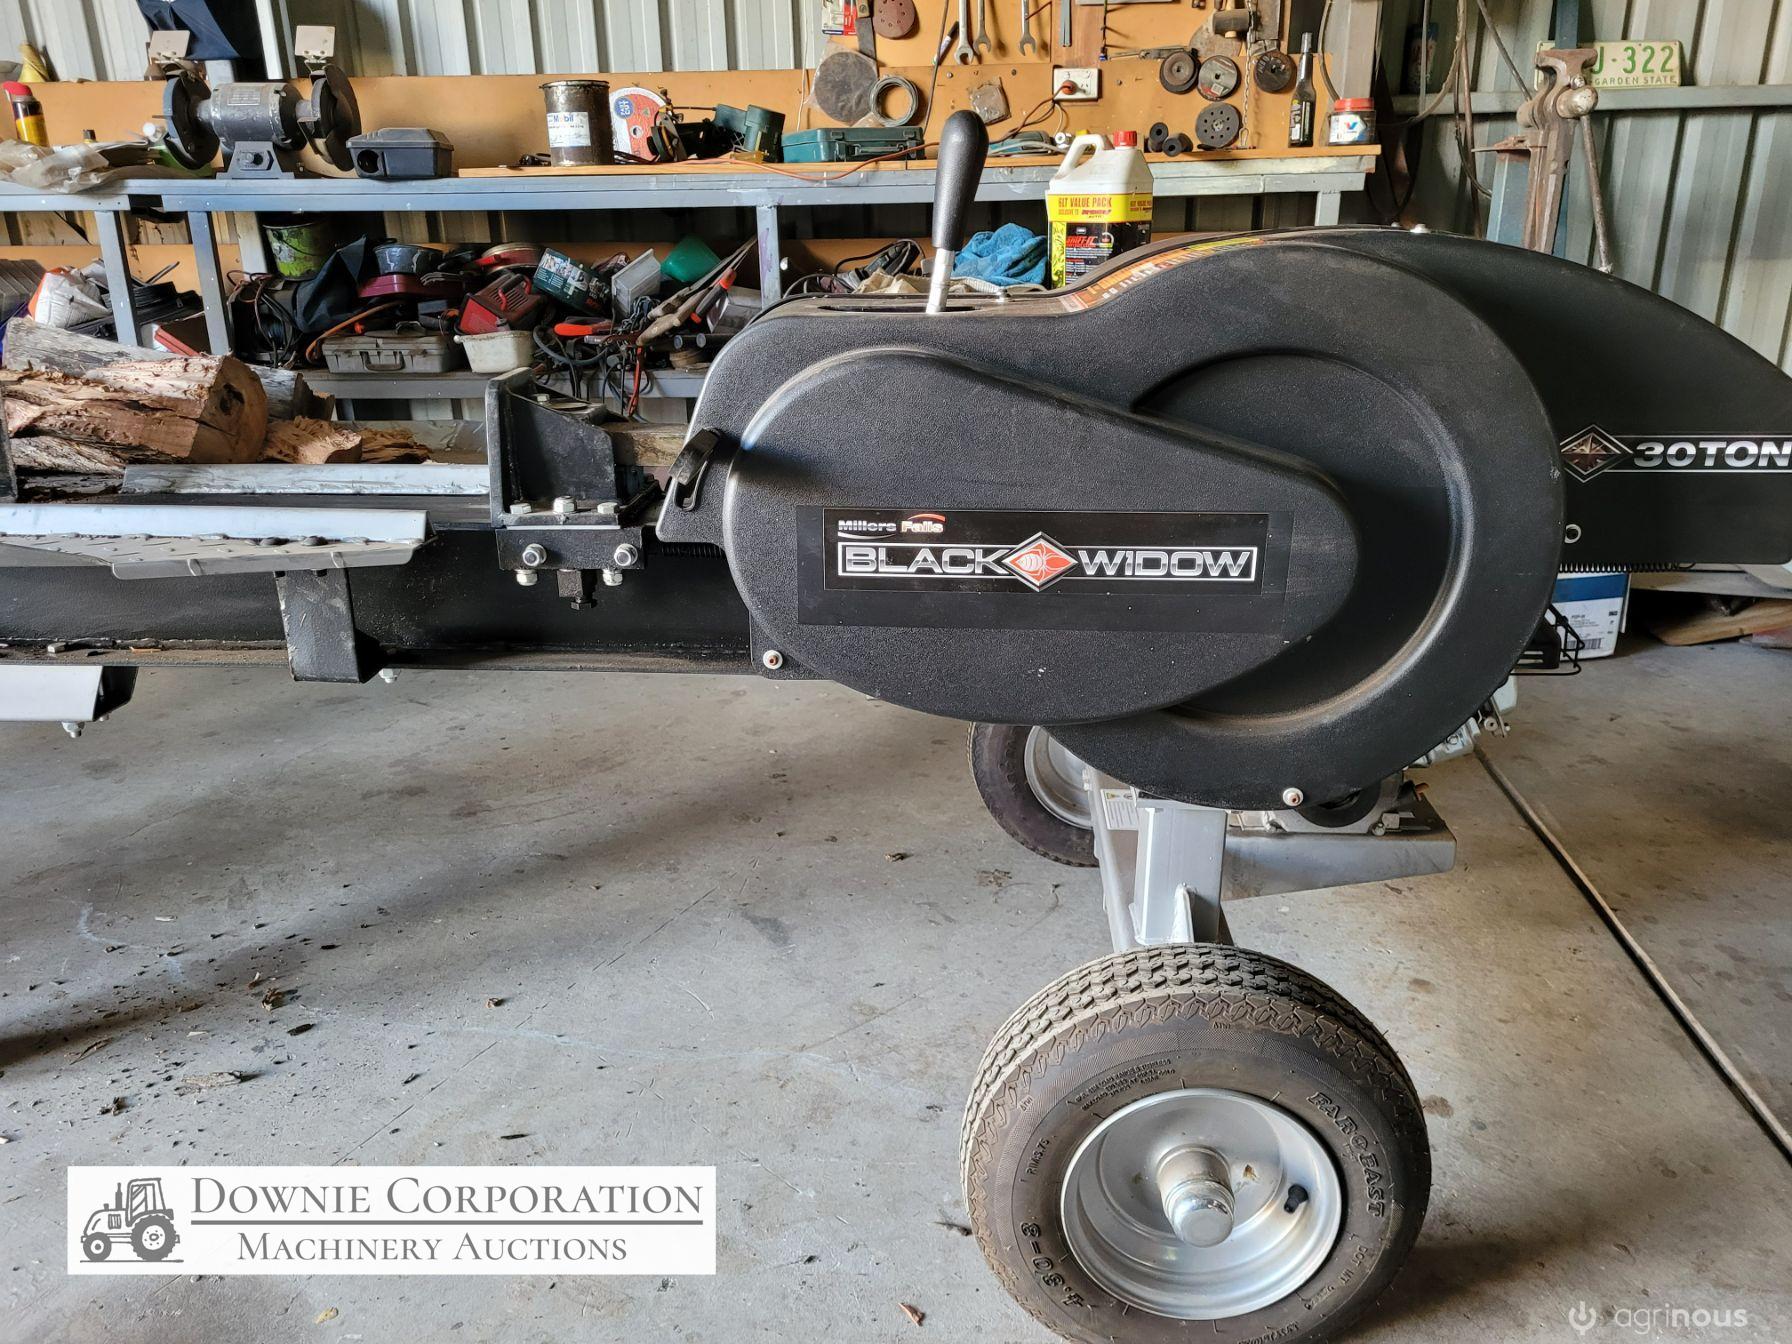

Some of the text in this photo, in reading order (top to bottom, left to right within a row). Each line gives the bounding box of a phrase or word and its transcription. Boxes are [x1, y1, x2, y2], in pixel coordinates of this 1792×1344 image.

[1594, 75, 1677, 86] GARDEN STATE
[1070, 197, 1090, 208] VALUE
[1092, 197, 1112, 208] PACK
[838, 519, 944, 533] Millers Falls
[845, 546, 1250, 577] BLACK WIDOW
[1358, 1152, 1385, 1218] EAST
